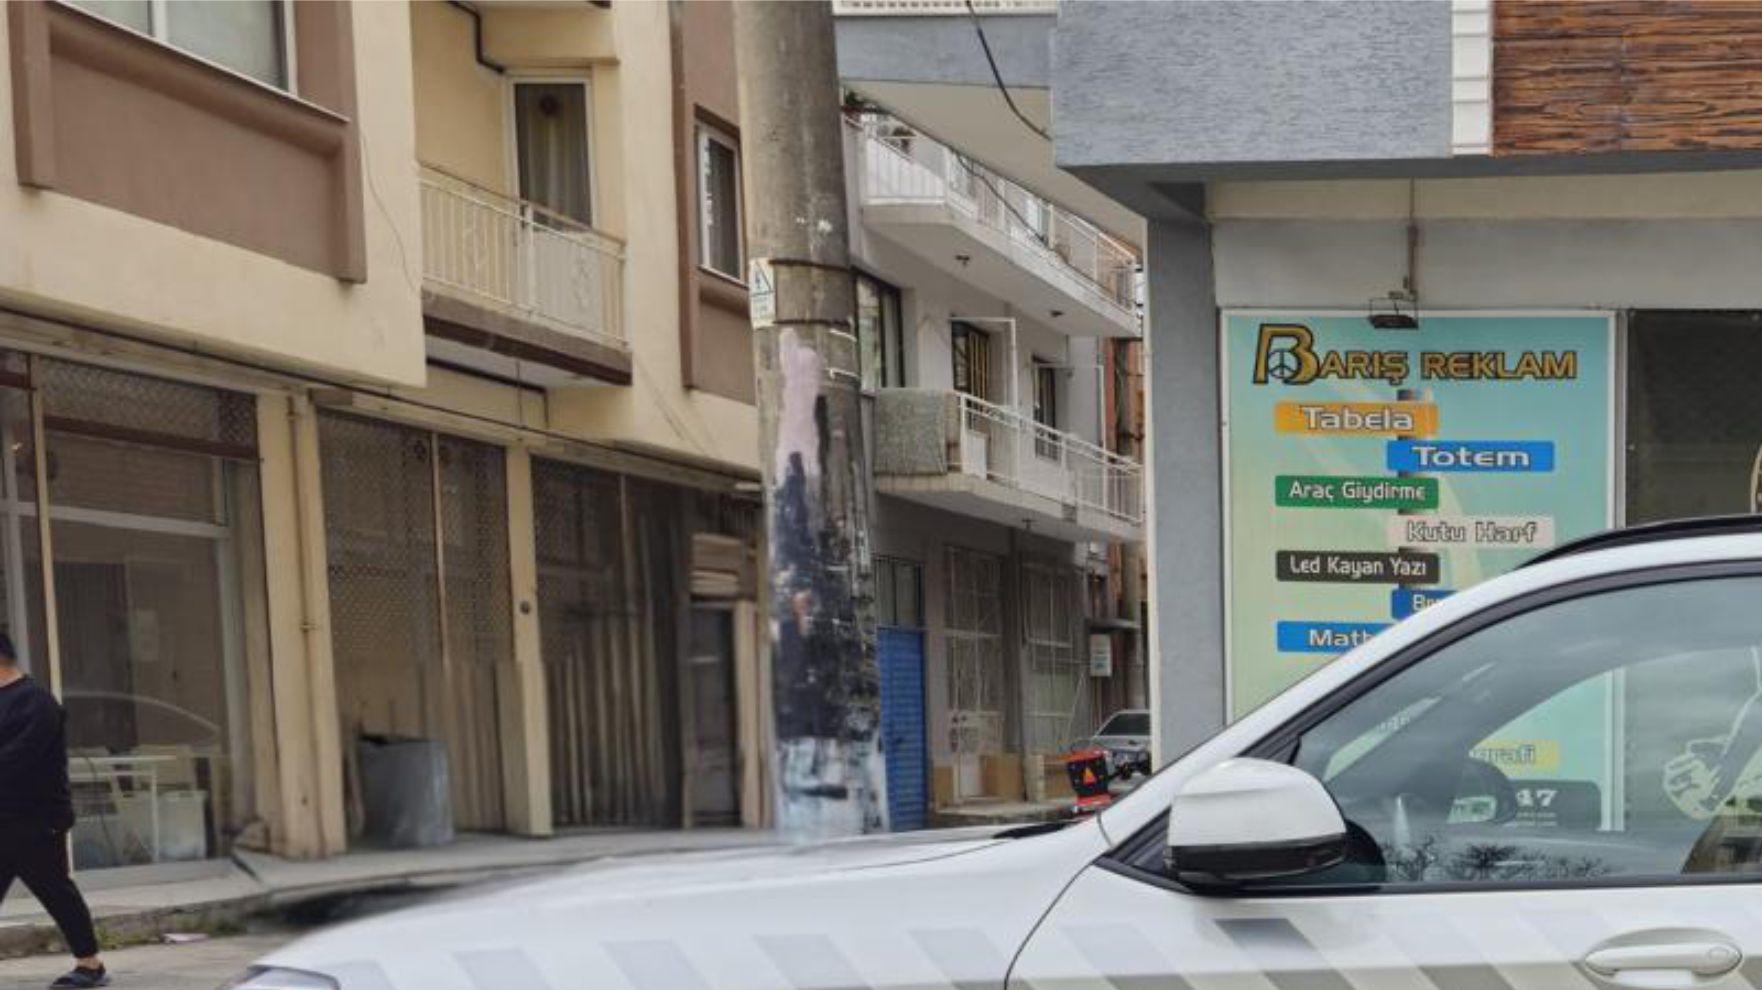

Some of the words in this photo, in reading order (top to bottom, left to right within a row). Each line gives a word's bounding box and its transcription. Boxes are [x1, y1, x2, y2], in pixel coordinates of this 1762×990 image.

[1253, 323, 1409, 385] BARIŞ
[1420, 350, 1578, 380] REKLAM
[1303, 406, 1414, 432] Tabela
[1412, 446, 1530, 468] Totem
[1289, 482, 1335, 502] Araç
[1342, 482, 1426, 505] Giydirme
[1406, 521, 1466, 542] Kutu
[1475, 521, 1538, 542] Harf
[1290, 556, 1321, 575] Led
[1327, 557, 1384, 579] Kayan
[1389, 557, 1427, 577] Yazı
